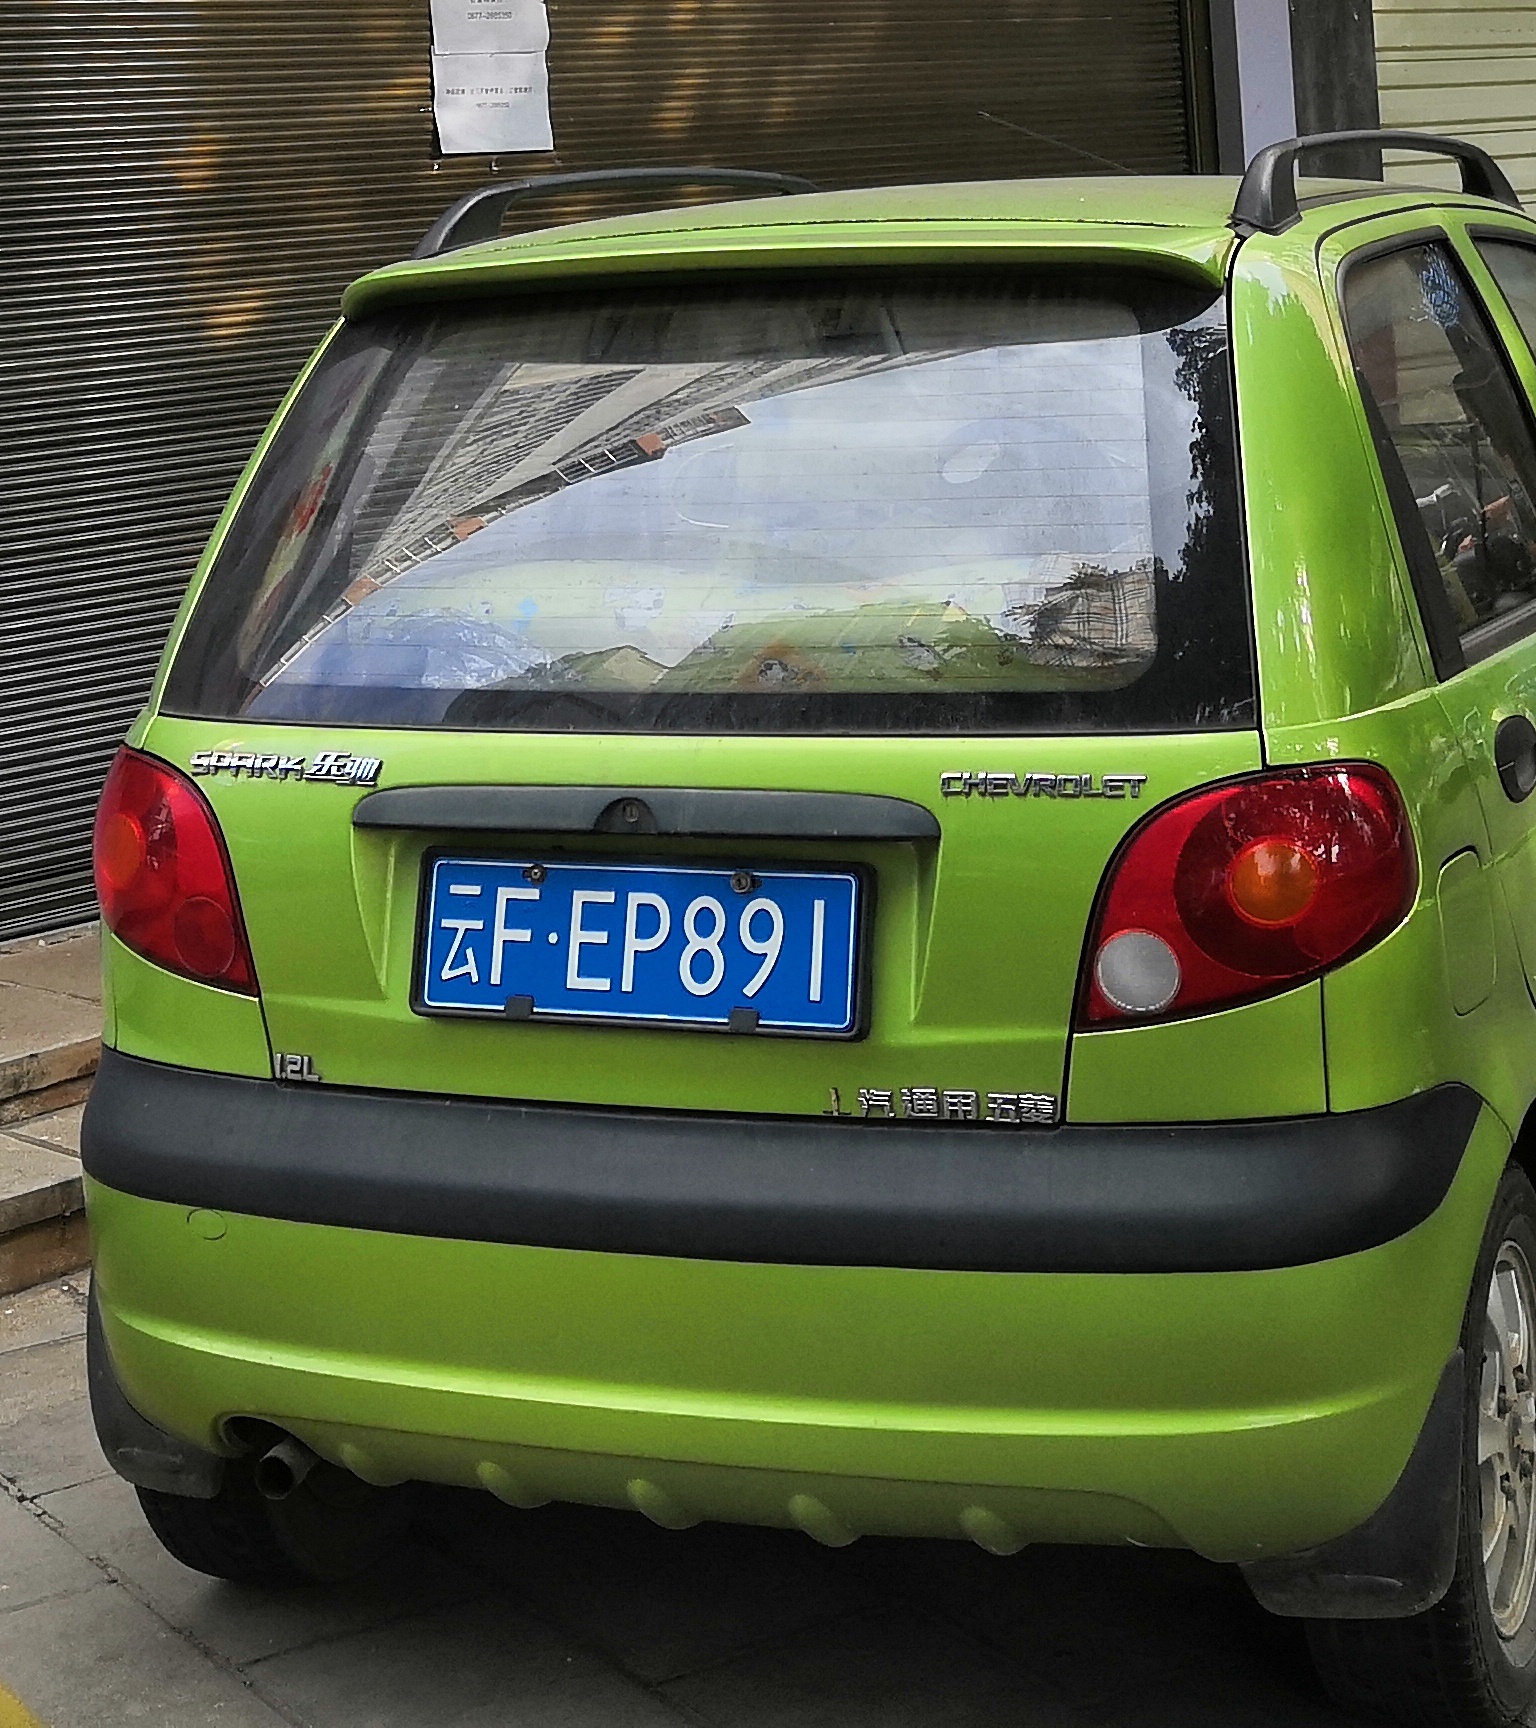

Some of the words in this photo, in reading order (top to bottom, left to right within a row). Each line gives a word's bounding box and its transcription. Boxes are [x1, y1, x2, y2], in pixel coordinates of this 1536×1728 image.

[940, 770, 1148, 799] CHEVROLET
[439, 883, 826, 1004] 云F·EP891
[822, 1086, 1057, 1124] 上汽通用五菱
